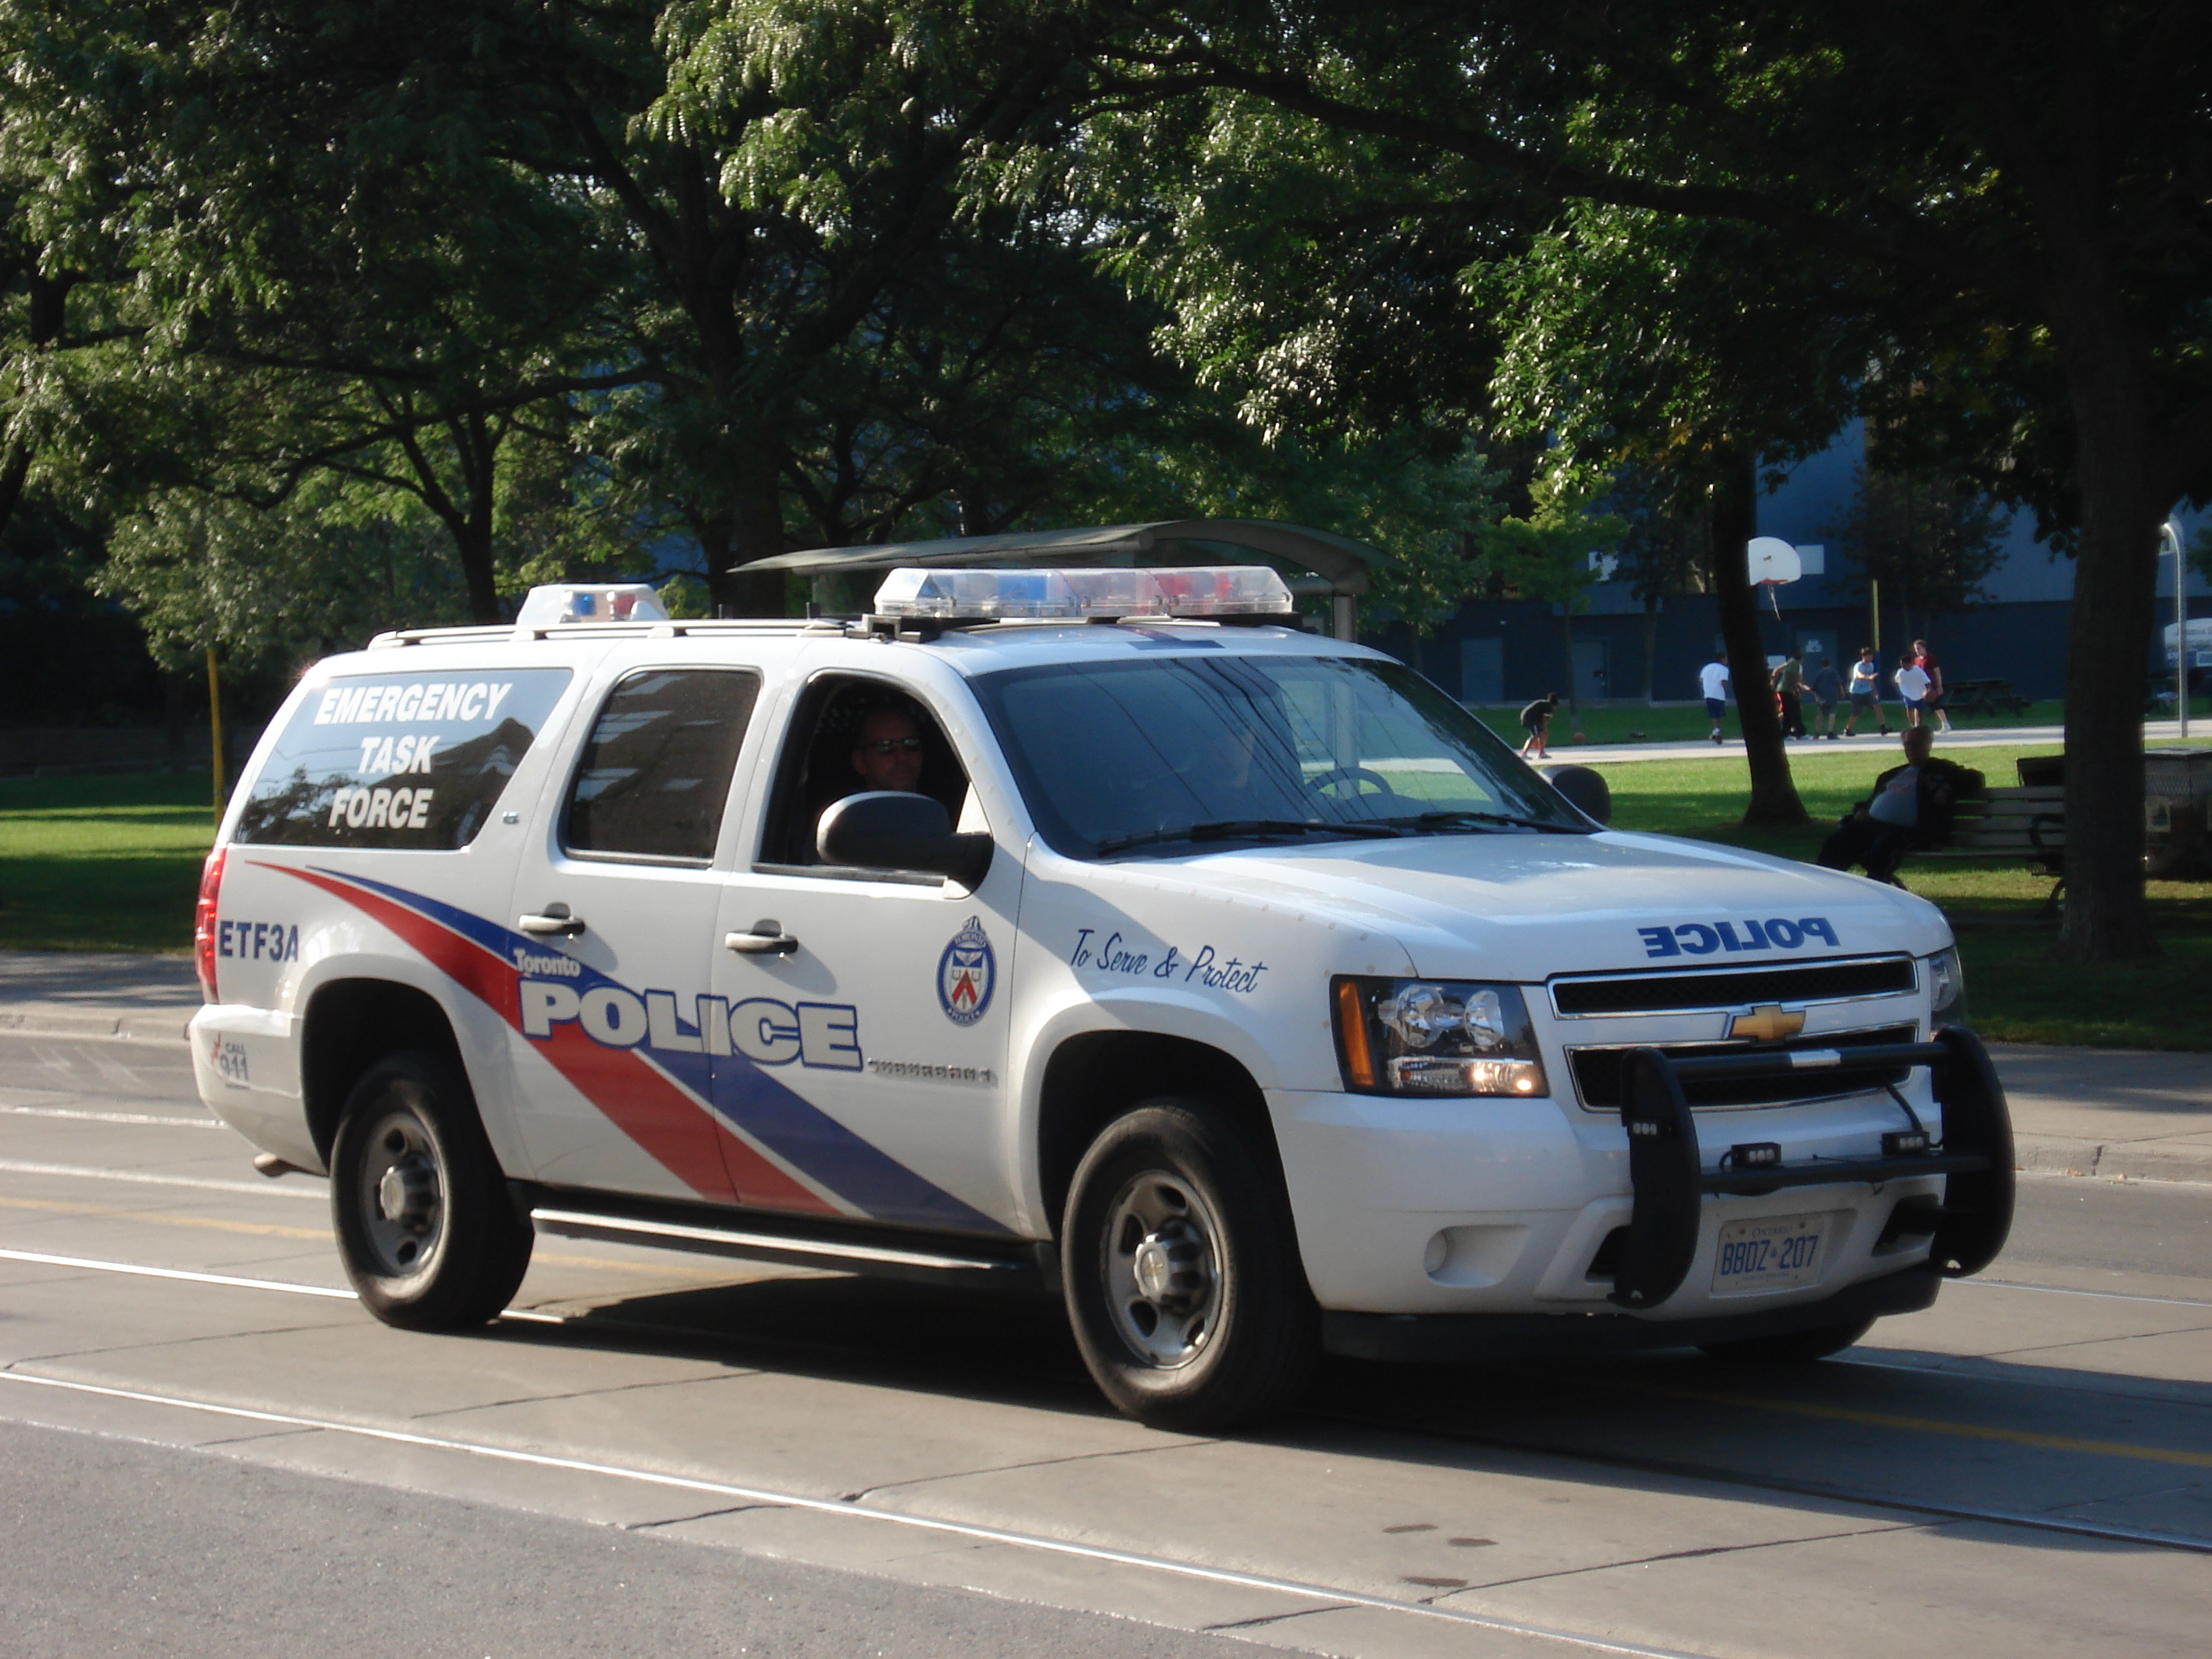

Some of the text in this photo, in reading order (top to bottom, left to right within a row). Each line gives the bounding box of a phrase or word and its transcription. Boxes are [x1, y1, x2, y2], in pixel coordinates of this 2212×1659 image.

[313, 683, 512, 725] EMERGENCY
[358, 735, 440, 775] TASK
[328, 787, 434, 829] FORCE
[219, 920, 298, 962] ETF3A
[1071, 928, 1269, 993] To Serve & Protect
[513, 947, 581, 977] Toronto
[518, 976, 862, 1071] POLICE
[220, 1054, 249, 1081] 911
[225, 1042, 246, 1054] CALL
[1720, 1235, 1818, 1276] BBDZ 207
